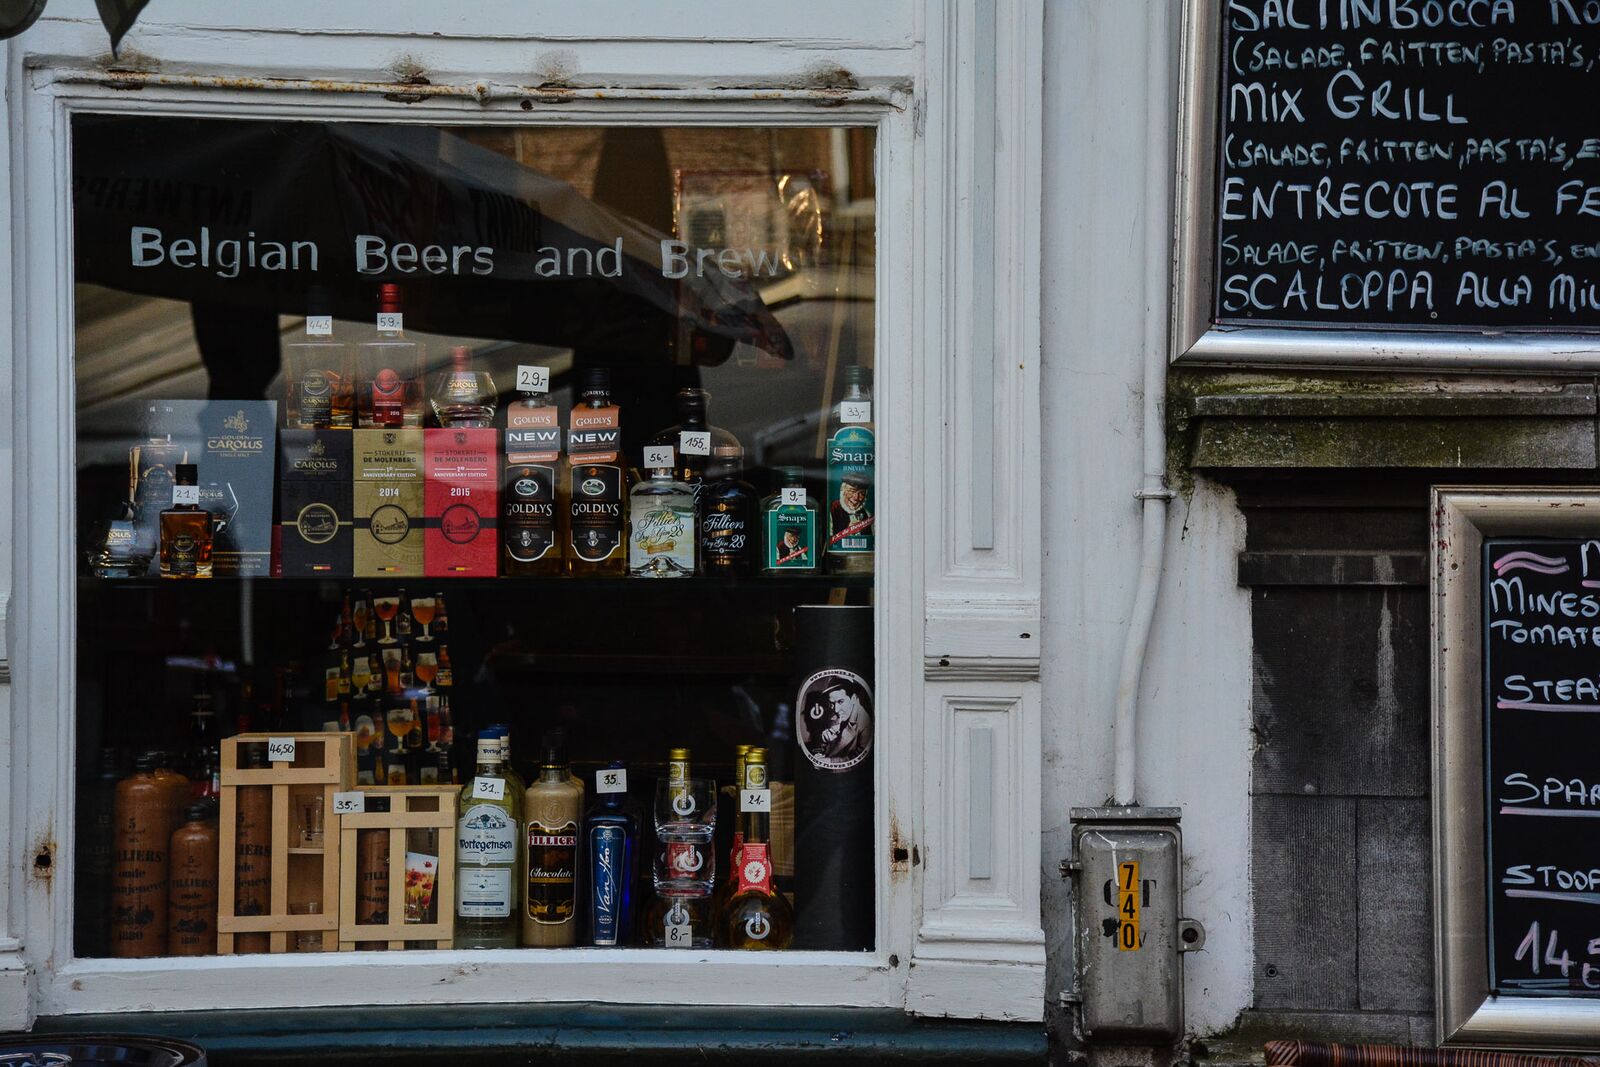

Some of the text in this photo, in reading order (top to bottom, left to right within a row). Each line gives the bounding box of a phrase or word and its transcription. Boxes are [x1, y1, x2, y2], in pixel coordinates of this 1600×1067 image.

[1326, 69, 1469, 123] GRILL
[1222, 175, 1459, 221] ENTRECOTE
[1479, 180, 1531, 219] AL
[130, 226, 319, 278] Belgian
[354, 235, 495, 276] Beers
[534, 237, 624, 278] and
[1223, 270, 1434, 312] SCALOPPA
[1456, 271, 1532, 308] ALLA
[576, 417, 612, 427] GOLDLYS
[509, 432, 557, 442] NEW
[571, 432, 617, 443] NEW
[208, 439, 263, 451] CAROLUS
[830, 448, 875, 466] Snap
[294, 461, 338, 470] CAROLUS
[379, 487, 400, 497] 2014
[451, 487, 471, 497] 2015
[505, 503, 552, 517] GOLDLYS
[571, 503, 619, 517] GOLDLYS
[703, 512, 745, 532] Filliers
[729, 534, 746, 549] 28
[1497, 674, 1600, 703] STEA
[269, 743, 295, 755] 46,50
